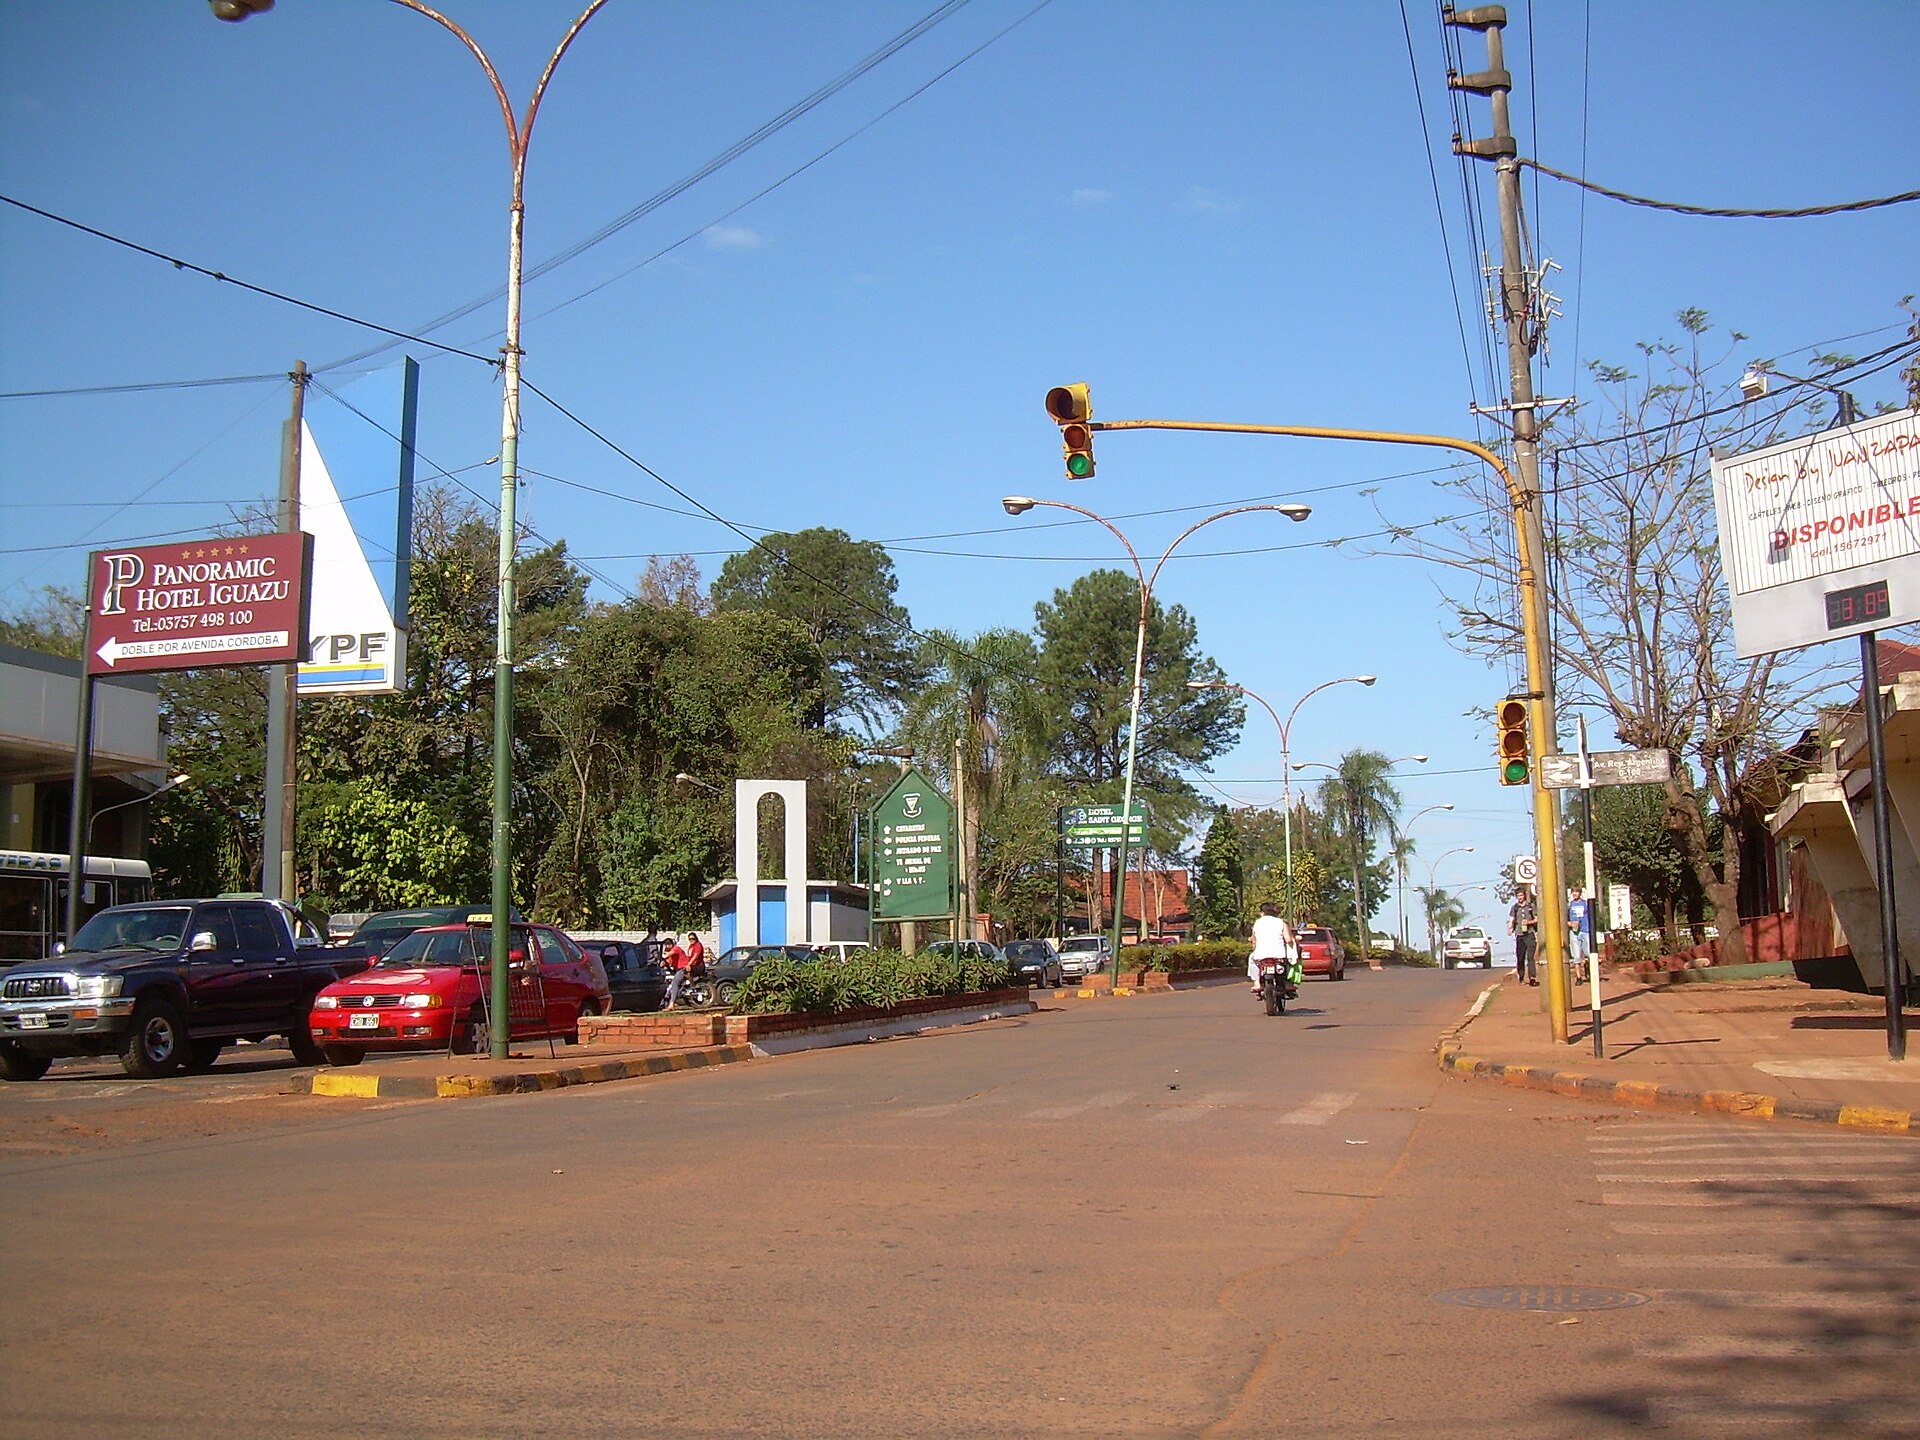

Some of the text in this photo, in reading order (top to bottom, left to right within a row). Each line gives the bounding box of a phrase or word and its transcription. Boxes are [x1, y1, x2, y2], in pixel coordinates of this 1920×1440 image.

[1744, 467, 1790, 498] Design
[1794, 459, 1820, 486] by
[1829, 446, 1869, 477] JUAN
[1774, 495, 1920, 551] DISPONIBLE
[153, 557, 276, 587] PANORAMIC
[136, 580, 290, 612] HOTEL IGUAZU
[200, 612, 225, 627] 498
[229, 610, 253, 625] 100
[121, 635, 280, 656] DOBLE POR AVENIDA CORDOBA
[1088, 808, 1114, 816] HOTEL
[1088, 816, 1111, 824] SAINT
